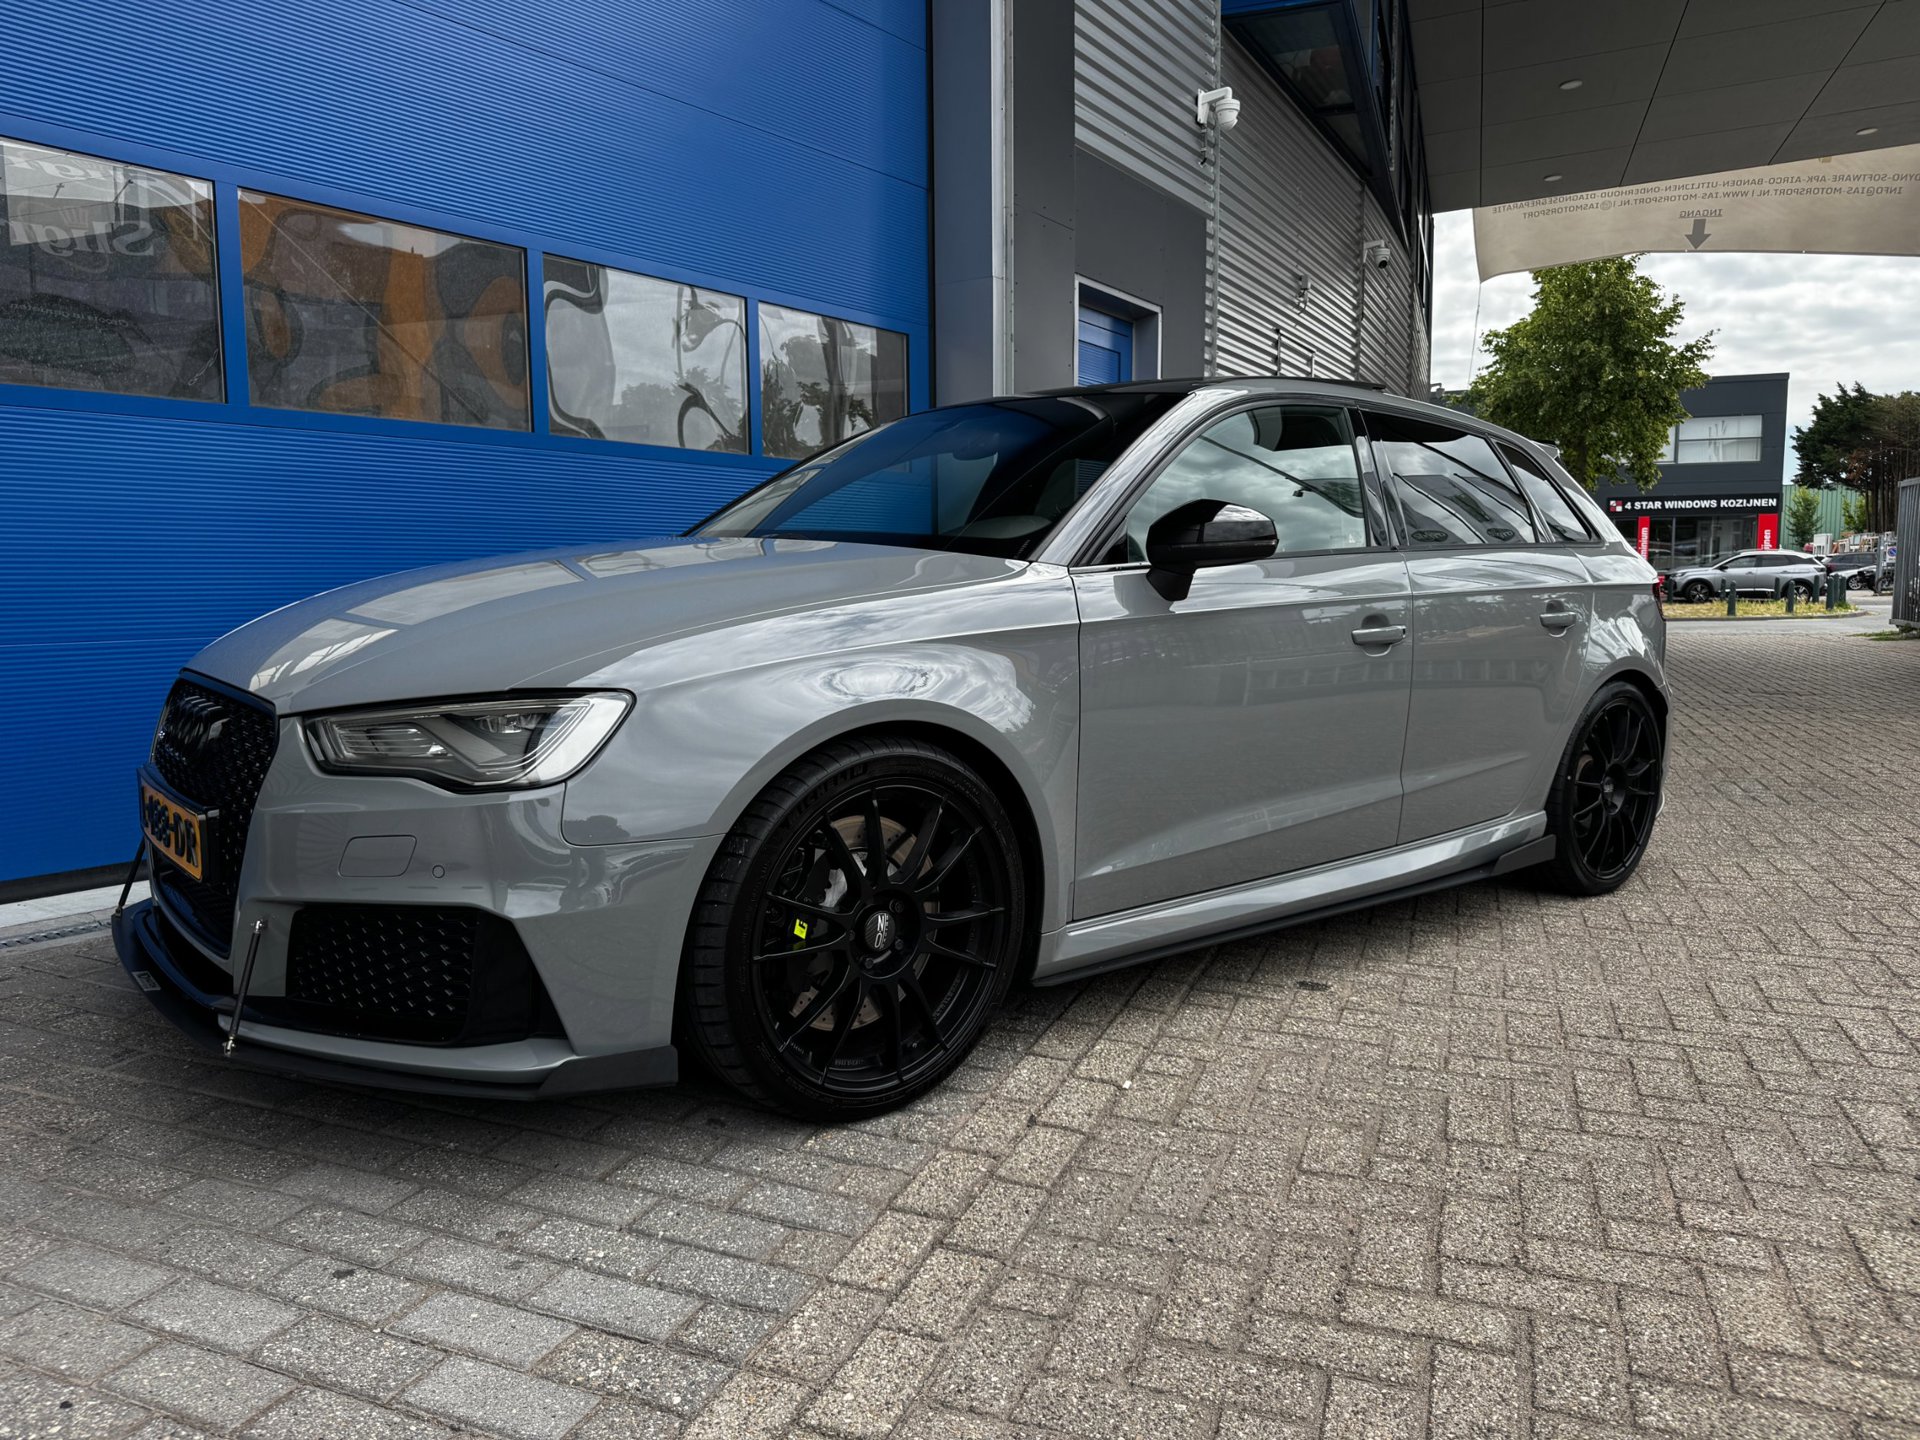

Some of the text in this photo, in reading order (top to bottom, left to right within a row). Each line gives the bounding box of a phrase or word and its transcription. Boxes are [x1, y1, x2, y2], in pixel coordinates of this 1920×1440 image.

[1624, 498, 1777, 510] 4 STAR WINDOWS KOZIJNEN
